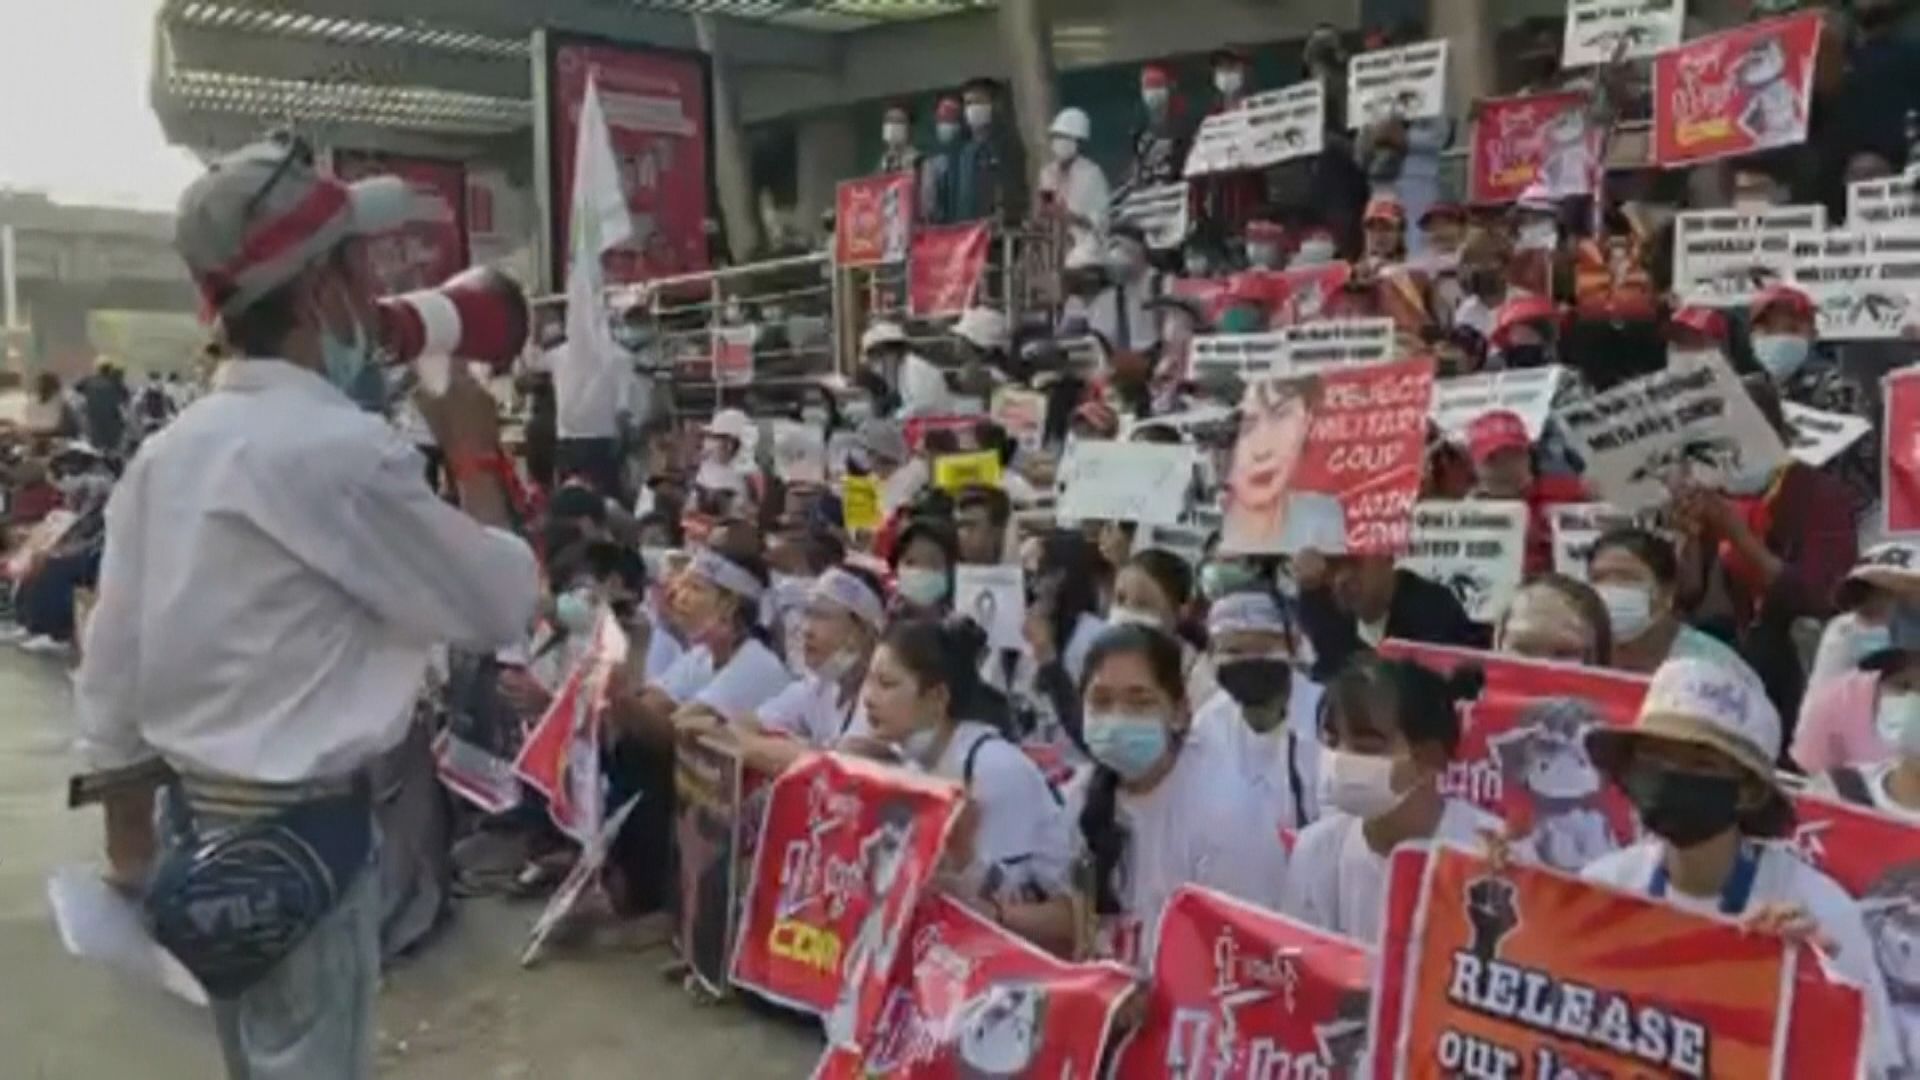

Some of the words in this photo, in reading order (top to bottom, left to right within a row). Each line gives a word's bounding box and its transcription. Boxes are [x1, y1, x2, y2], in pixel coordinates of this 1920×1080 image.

[1325, 372, 1432, 409] REJECT
[1310, 406, 1428, 442] MILITARY
[1327, 443, 1405, 473] COUP
[1348, 487, 1418, 518] JOIN
[1449, 951, 1706, 1078] RELEASE
[1438, 1031, 1517, 1080] our
